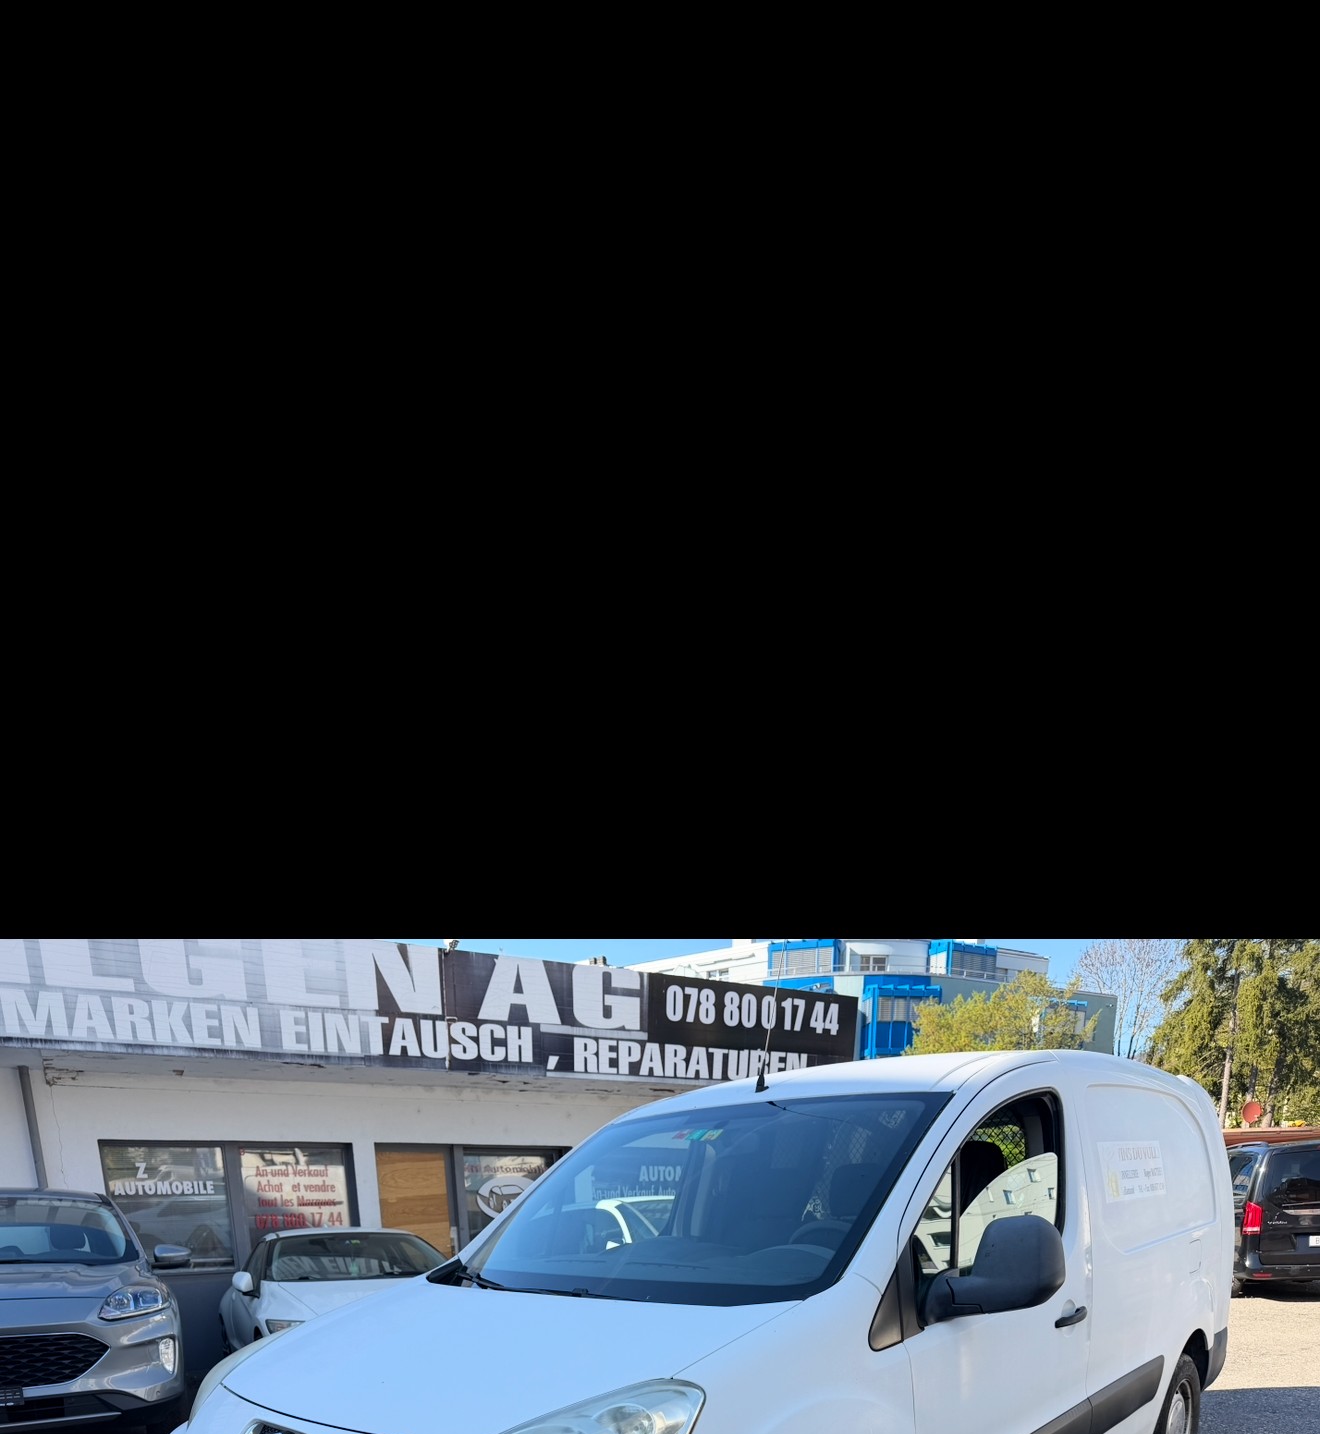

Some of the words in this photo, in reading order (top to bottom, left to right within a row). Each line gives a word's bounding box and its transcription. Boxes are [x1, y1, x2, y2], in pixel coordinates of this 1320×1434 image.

[477, 955, 641, 1031] AG
[666, 985, 716, 1025] 078
[781, 997, 806, 1032] 17
[810, 1001, 839, 1036] 44
[0, 987, 262, 1048] MARKEN
[279, 1009, 533, 1063] EINTAUSCH
[135, 1162, 148, 1179] Z
[291, 1164, 329, 1177] Verkauf
[114, 1180, 215, 1196] AUTOMOBILE
[256, 1180, 283, 1193] Achat
[292, 1182, 301, 1193] et
[303, 1180, 336, 1193] vendre
[280, 1194, 295, 1208] les
[310, 1211, 324, 1228] 17
[327, 1210, 344, 1226] 44
